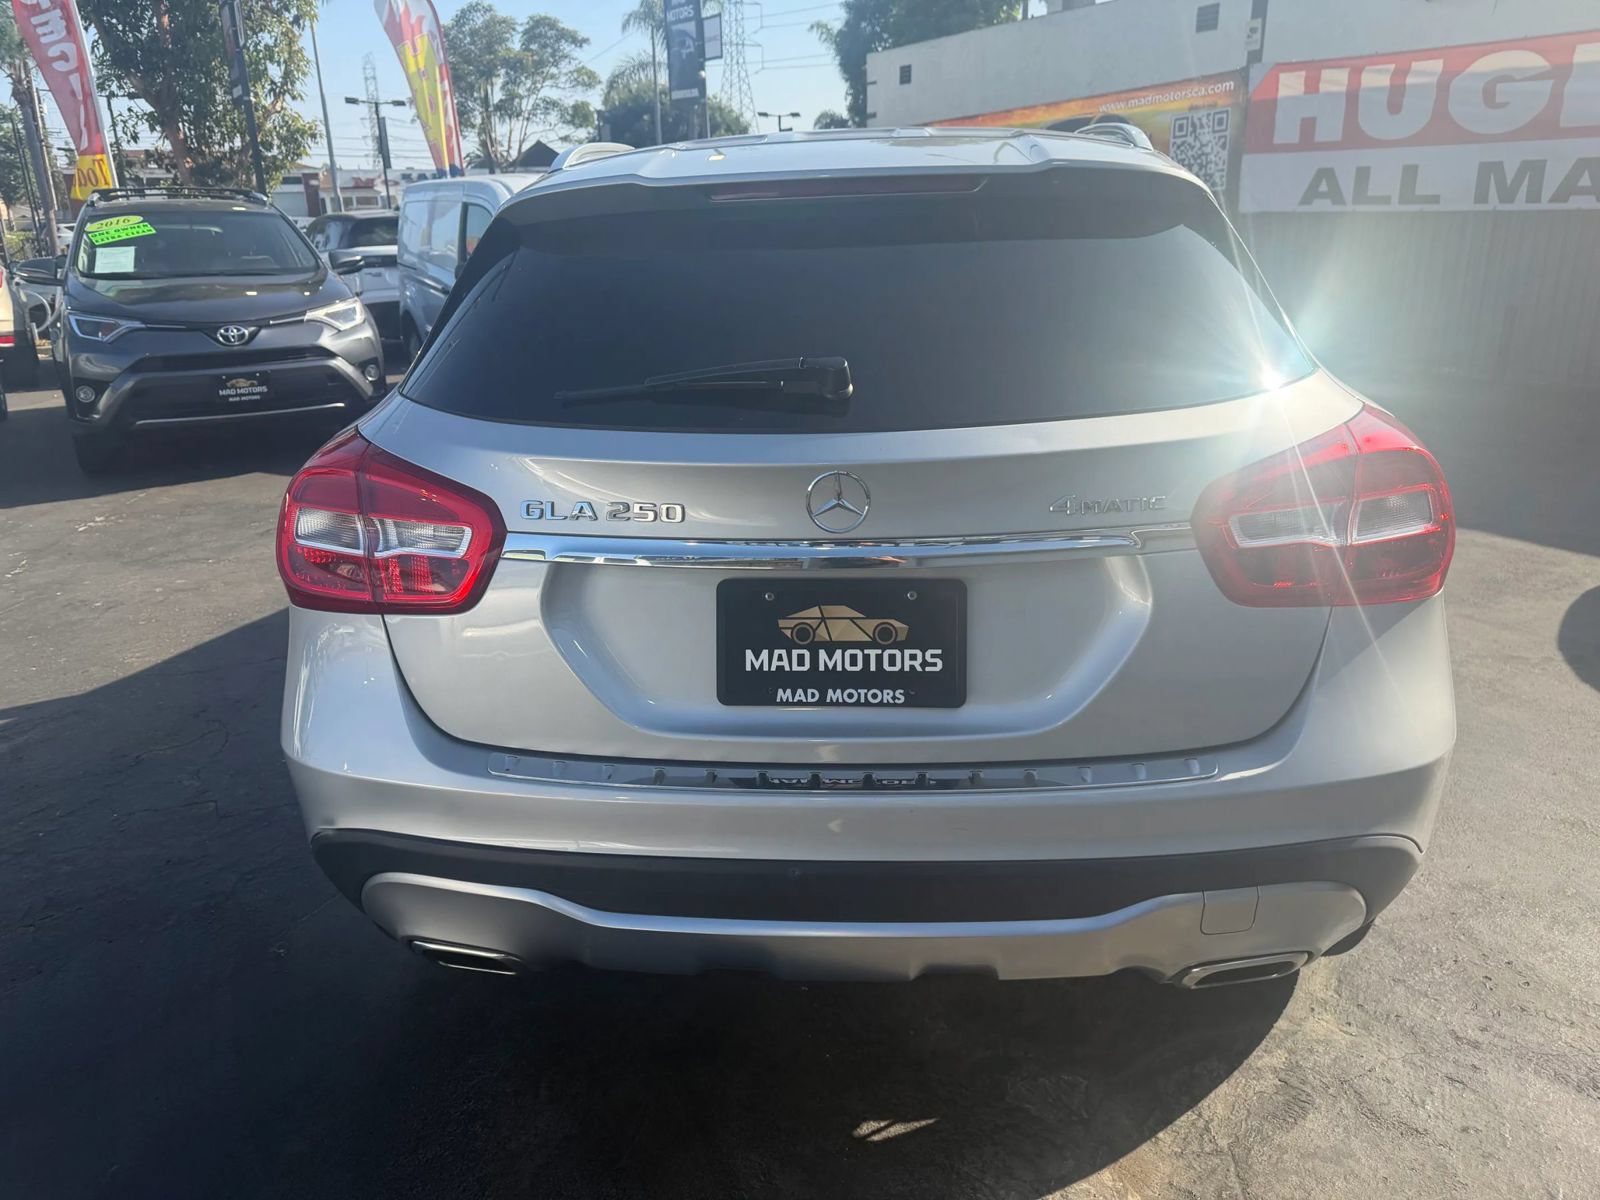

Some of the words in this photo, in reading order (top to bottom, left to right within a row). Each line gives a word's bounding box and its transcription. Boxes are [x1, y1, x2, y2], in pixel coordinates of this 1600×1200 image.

[1099, 80, 1235, 113] www.madmotorsca.com
[1298, 164, 1441, 206] ALL
[97, 219, 130, 229] 2016
[219, 388, 236, 396] MAD
[237, 386, 267, 394] MOTORS
[520, 500, 598, 521] GLA
[605, 502, 685, 523] 250
[1049, 495, 1168, 515] 4MATIC
[745, 649, 810, 672] MAD
[818, 649, 943, 672] MOTORS
[776, 688, 820, 703] MAD
[826, 689, 905, 704] MOTORS
